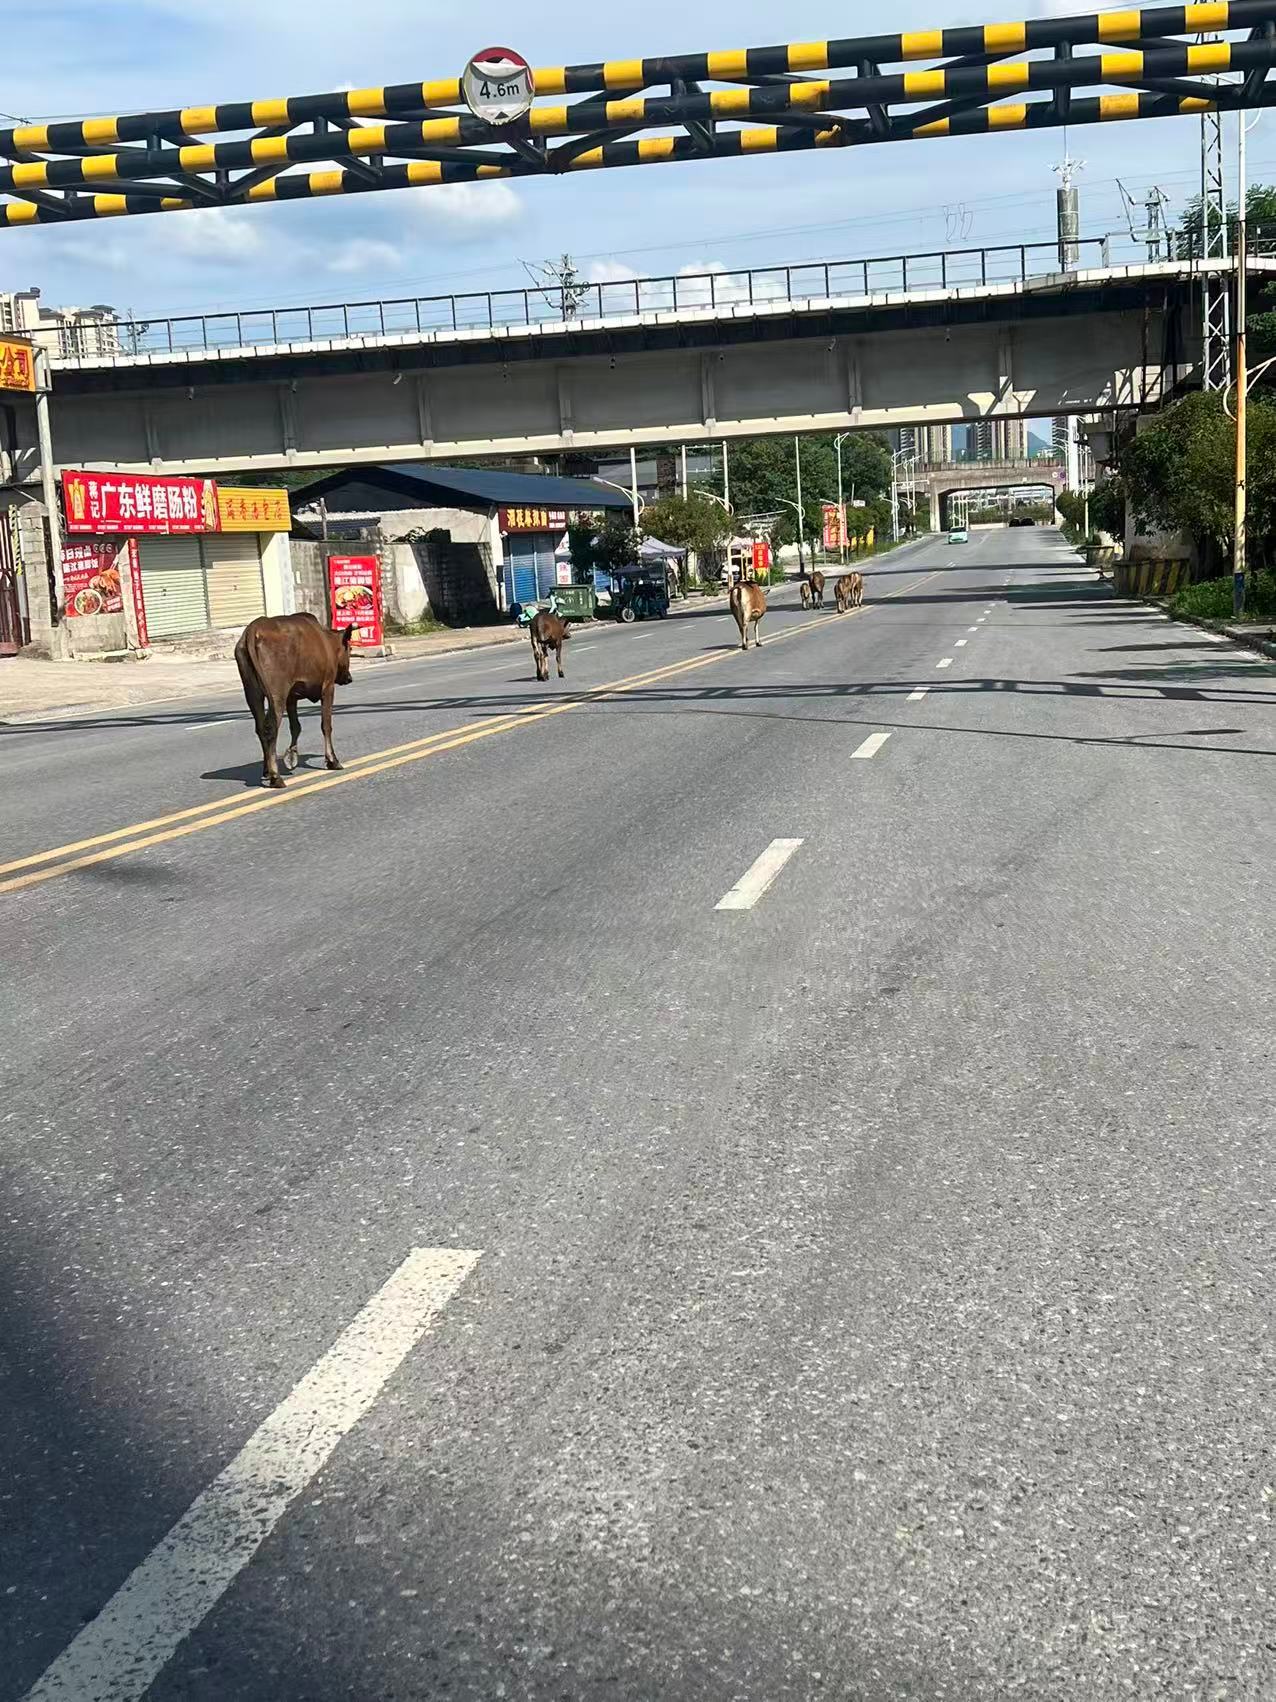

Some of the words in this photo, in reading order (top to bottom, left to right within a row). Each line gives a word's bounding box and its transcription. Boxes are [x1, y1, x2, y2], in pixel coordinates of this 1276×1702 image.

[479, 80, 520, 99] 4.6m
[100, 482, 198, 519] 广东鲜磨肠粉
